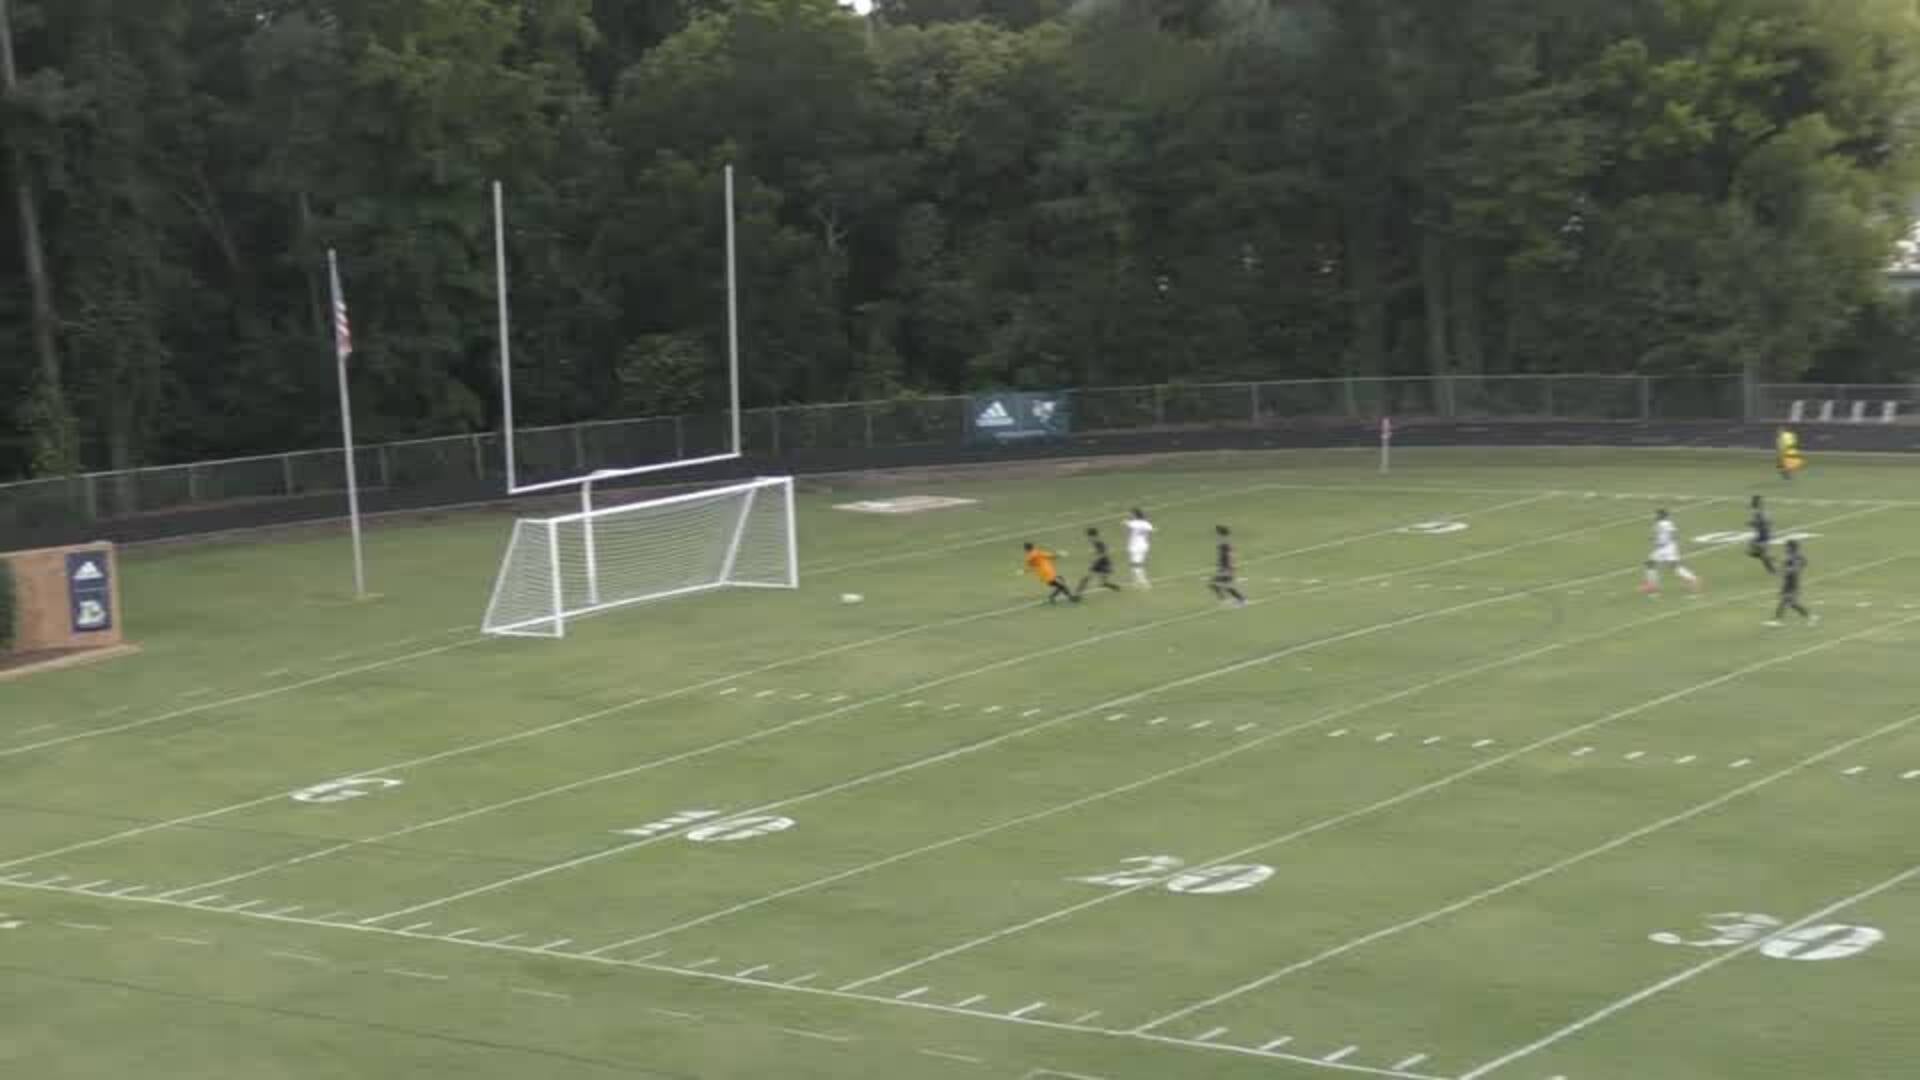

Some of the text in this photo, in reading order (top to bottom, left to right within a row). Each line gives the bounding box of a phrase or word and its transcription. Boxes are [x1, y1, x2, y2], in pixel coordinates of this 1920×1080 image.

[612, 809, 797, 841] 10
[1068, 855, 1276, 893] 20
[1648, 911, 1884, 960] 30
